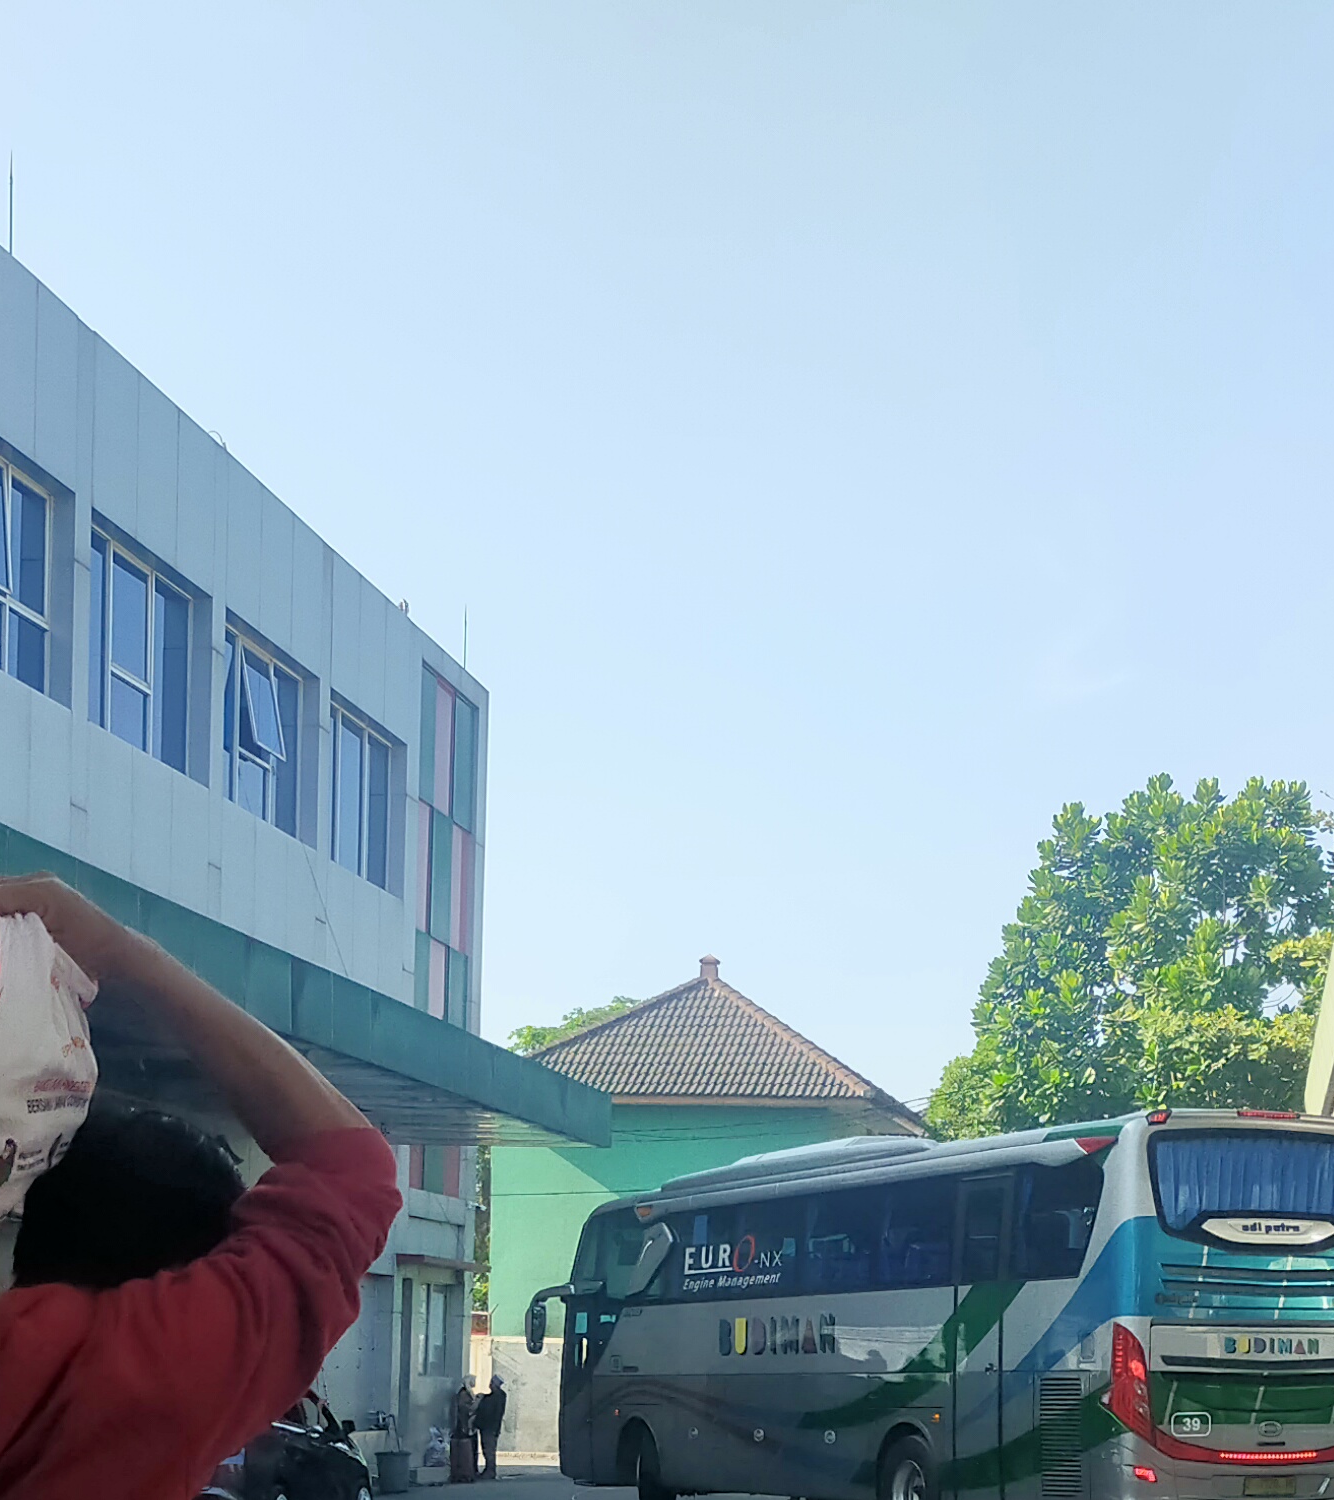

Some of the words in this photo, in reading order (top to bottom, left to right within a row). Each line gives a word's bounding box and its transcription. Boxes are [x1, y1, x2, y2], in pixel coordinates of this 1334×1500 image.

[1242, 1218, 1262, 1233] adi
[1264, 1220, 1301, 1235] putra
[683, 1234, 783, 1275] EURO-NX
[682, 1277, 715, 1293] Engine
[716, 1272, 782, 1290] Management
[719, 1312, 836, 1357] BUDIMAN
[1224, 1336, 1320, 1356] BUDIMAN
[1181, 1417, 1201, 1432] 39
